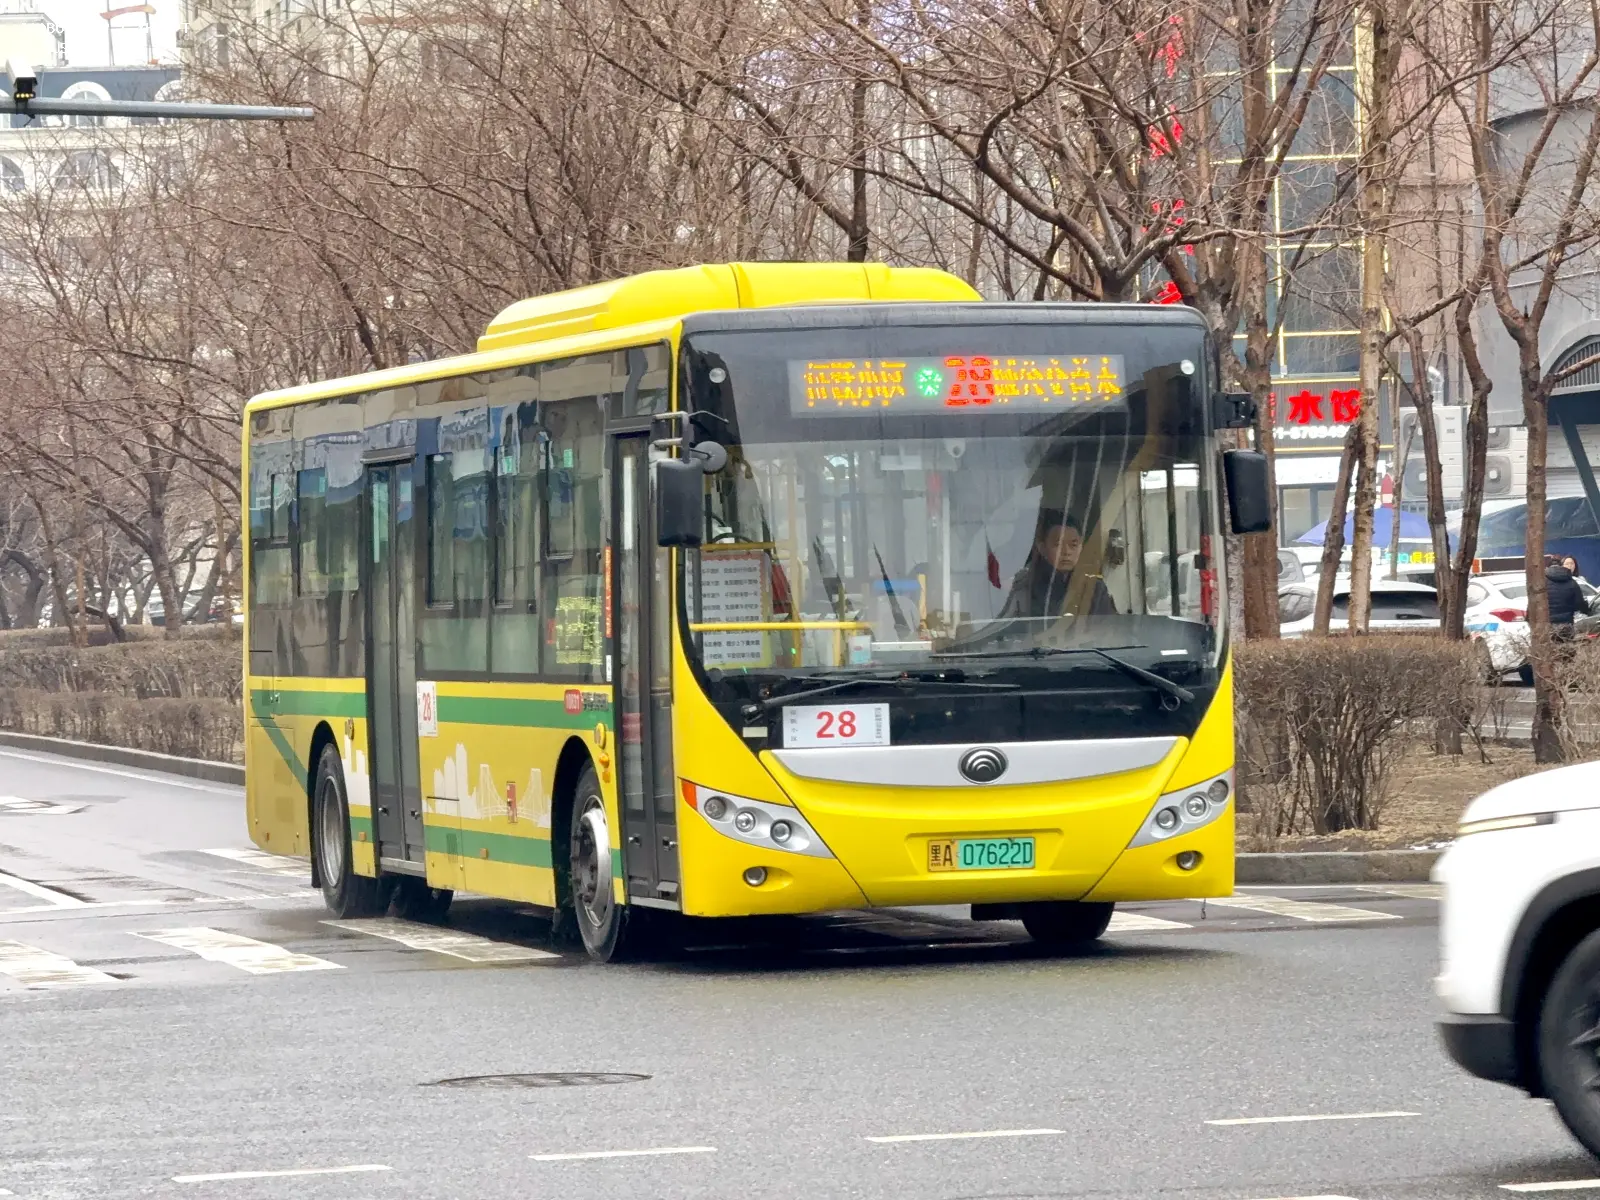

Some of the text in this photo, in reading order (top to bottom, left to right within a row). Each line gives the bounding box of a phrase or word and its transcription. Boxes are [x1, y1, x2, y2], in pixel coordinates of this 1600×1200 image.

[1270, 389, 1362, 424] 水饺
[816, 710, 857, 738] 28
[963, 841, 1033, 866] 07622D
